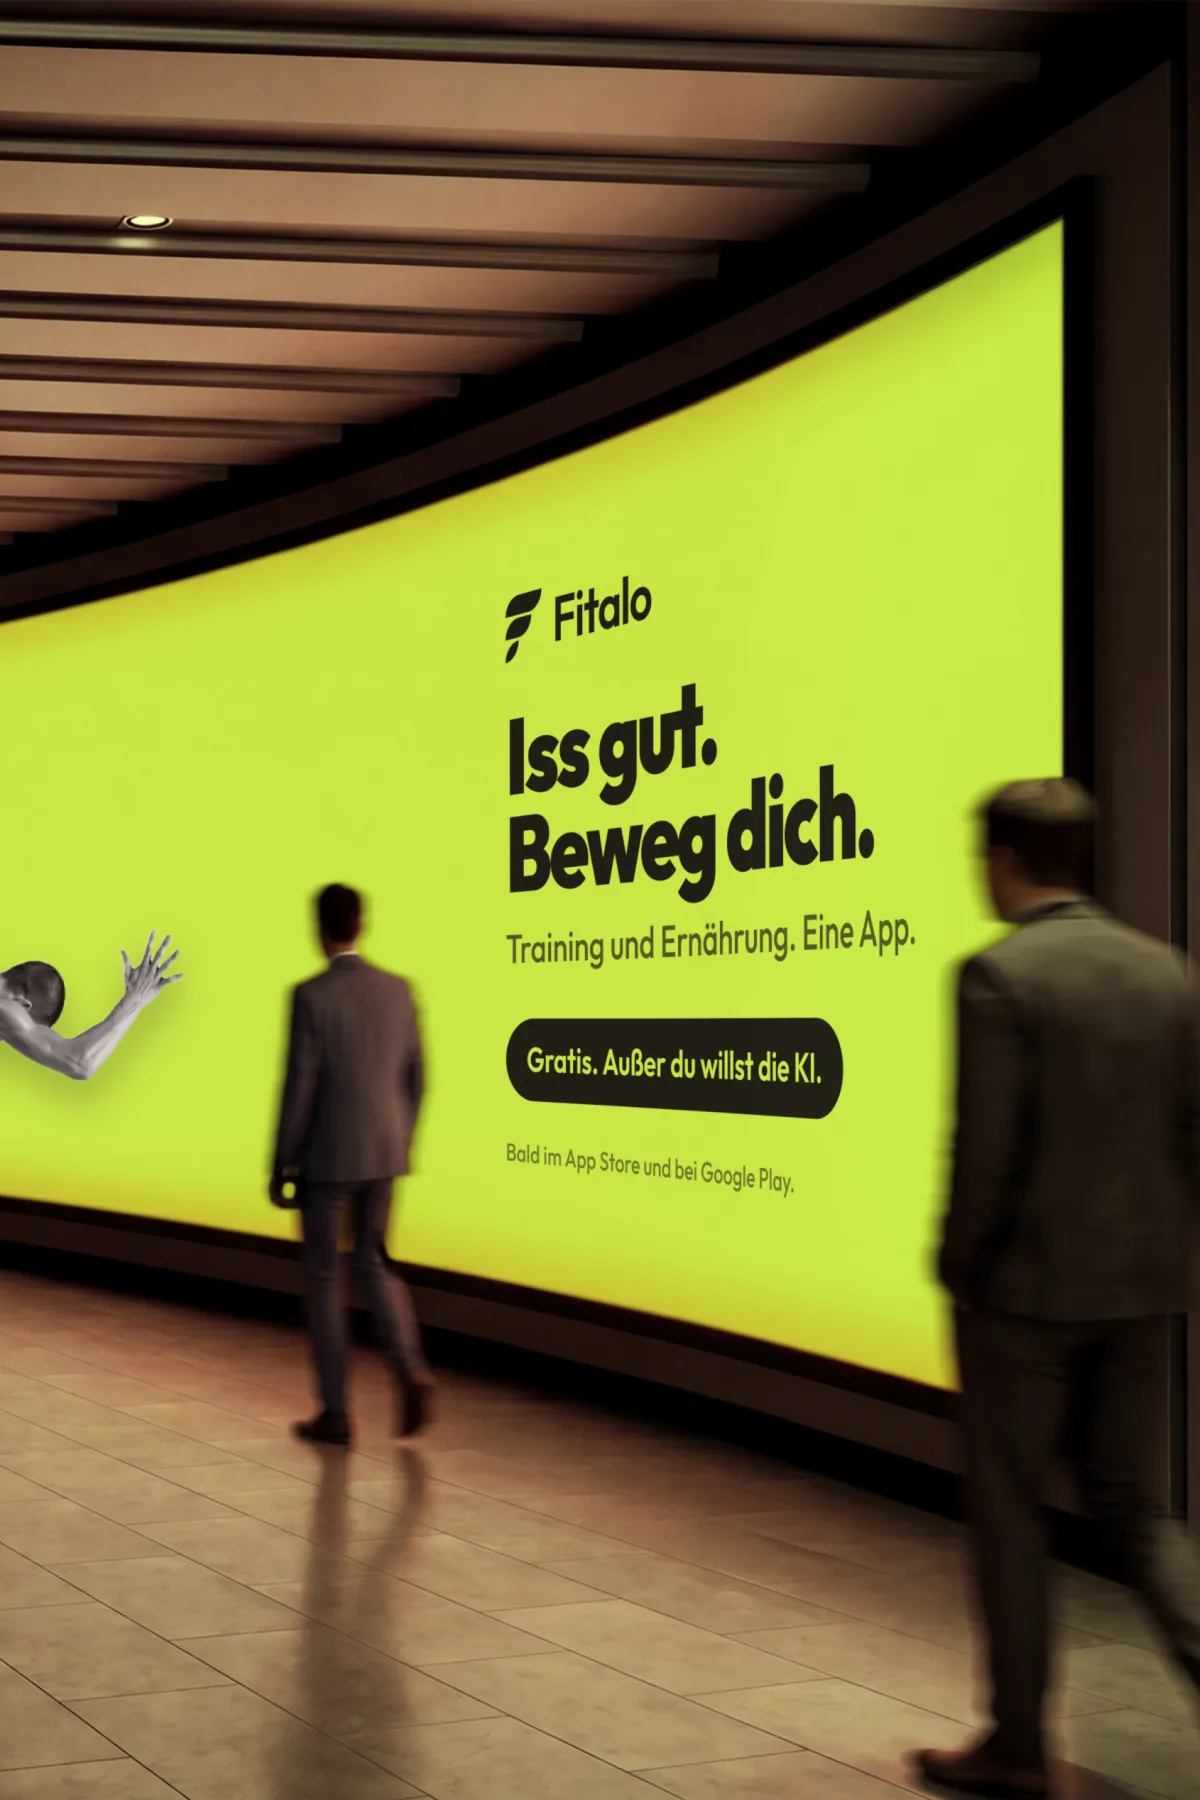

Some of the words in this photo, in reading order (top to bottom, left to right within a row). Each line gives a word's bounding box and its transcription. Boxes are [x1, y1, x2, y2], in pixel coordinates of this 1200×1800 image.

[555, 576, 652, 641] Fitalo
[509, 717, 591, 796] Iss
[599, 683, 717, 806] gut.
[509, 814, 716, 903] Beweg
[727, 764, 874, 872] dich.
[506, 932, 603, 969] Training
[611, 926, 654, 960] und
[662, 921, 795, 961] Ernährung.
[804, 914, 853, 950] Eine
[860, 910, 915, 956] App.
[527, 1047, 597, 1074] Gratis.
[603, 1048, 666, 1077] Außer
[671, 1050, 695, 1078] du
[700, 1050, 753, 1080] willst
[759, 1051, 789, 1082] die
[795, 1053, 821, 1083] KI.
[507, 1143, 539, 1164] Bald
[544, 1146, 561, 1166] im
[565, 1149, 596, 1175] App
[600, 1152, 640, 1175] Store
[644, 1157, 671, 1178] und
[675, 1158, 697, 1181] bei
[701, 1161, 755, 1192] Google
[759, 1168, 794, 1198] Play.
